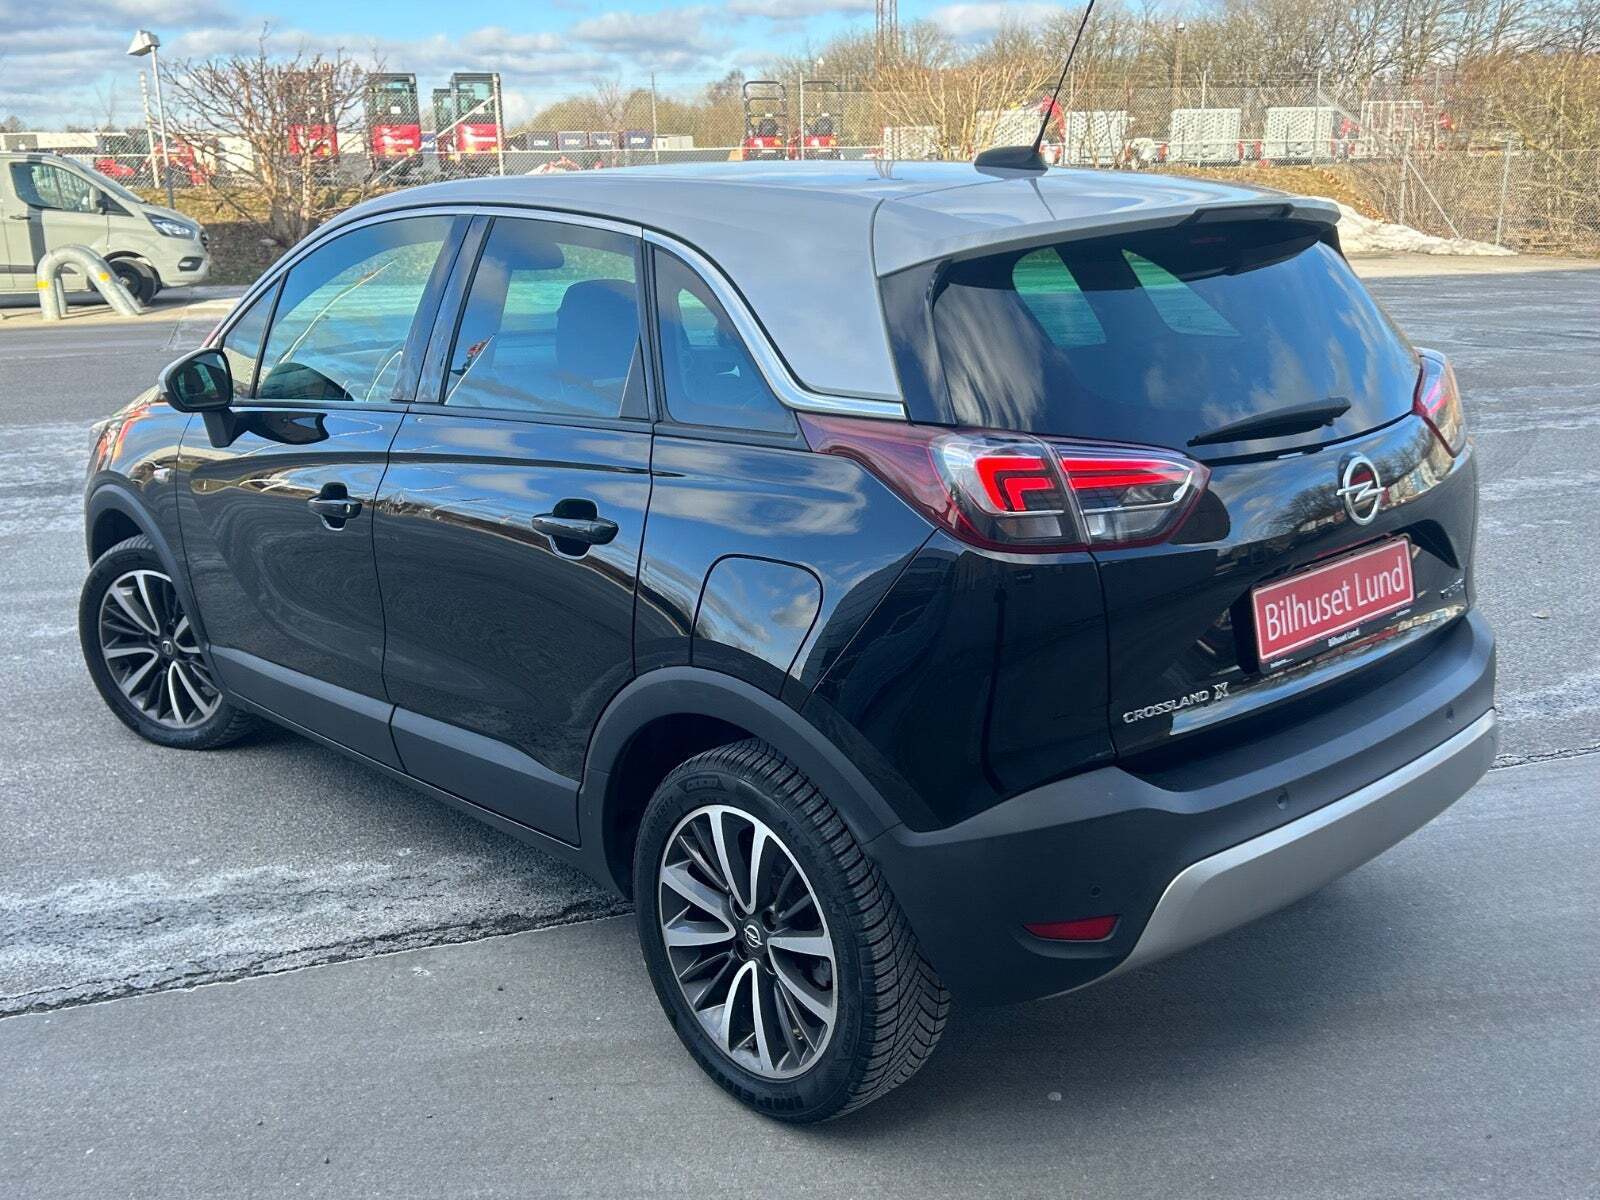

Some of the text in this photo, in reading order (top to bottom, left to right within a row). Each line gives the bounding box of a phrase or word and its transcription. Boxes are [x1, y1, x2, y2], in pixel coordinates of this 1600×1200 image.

[1264, 580, 1352, 641] Bilhuset
[1354, 556, 1405, 607] Lund
[1122, 681, 1230, 723] CROSSLAND X
